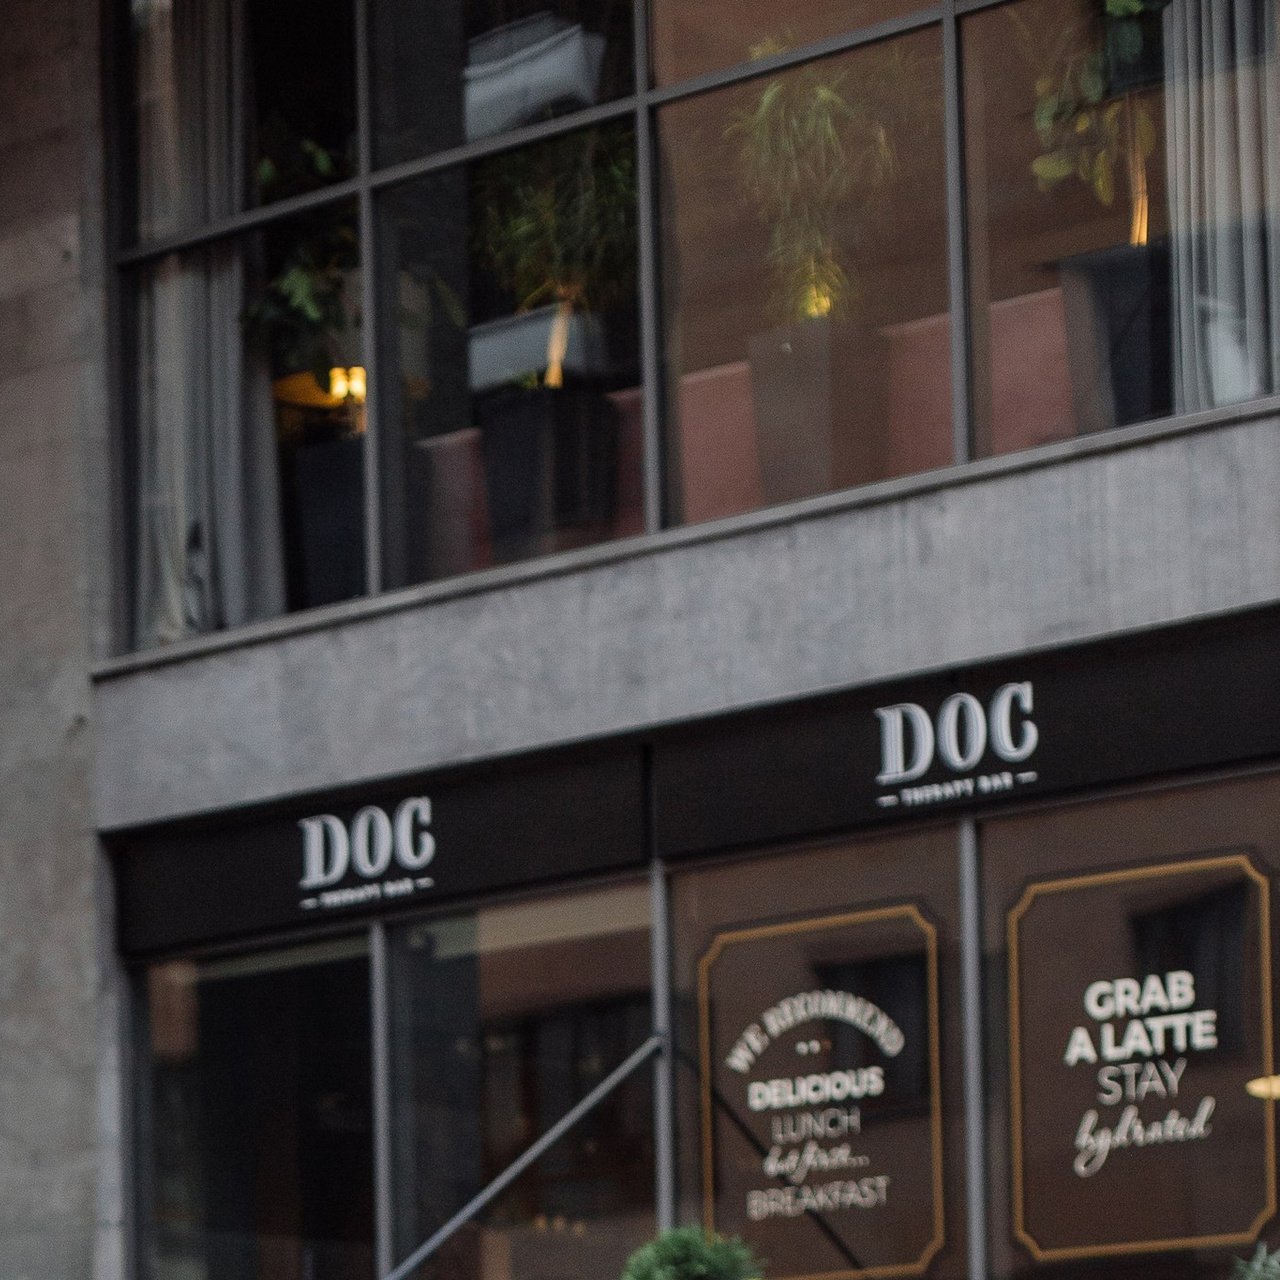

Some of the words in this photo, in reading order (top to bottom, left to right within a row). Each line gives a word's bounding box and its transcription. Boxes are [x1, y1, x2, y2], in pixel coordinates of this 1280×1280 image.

[874, 681, 1039, 786] DOC
[298, 796, 436, 890] DOC
[1084, 970, 1195, 1021] GRAB
[725, 1023, 769, 1074] WE
[1064, 1026, 1098, 1066] A
[1101, 1009, 1218, 1062] LATTE
[748, 1066, 884, 1111] DELICIOUS
[1096, 1057, 1187, 1105] STAY
[772, 1106, 861, 1144] LUNCH
[1073, 1096, 1216, 1178] hydrated
[746, 1175, 891, 1221] BREAKFAST
